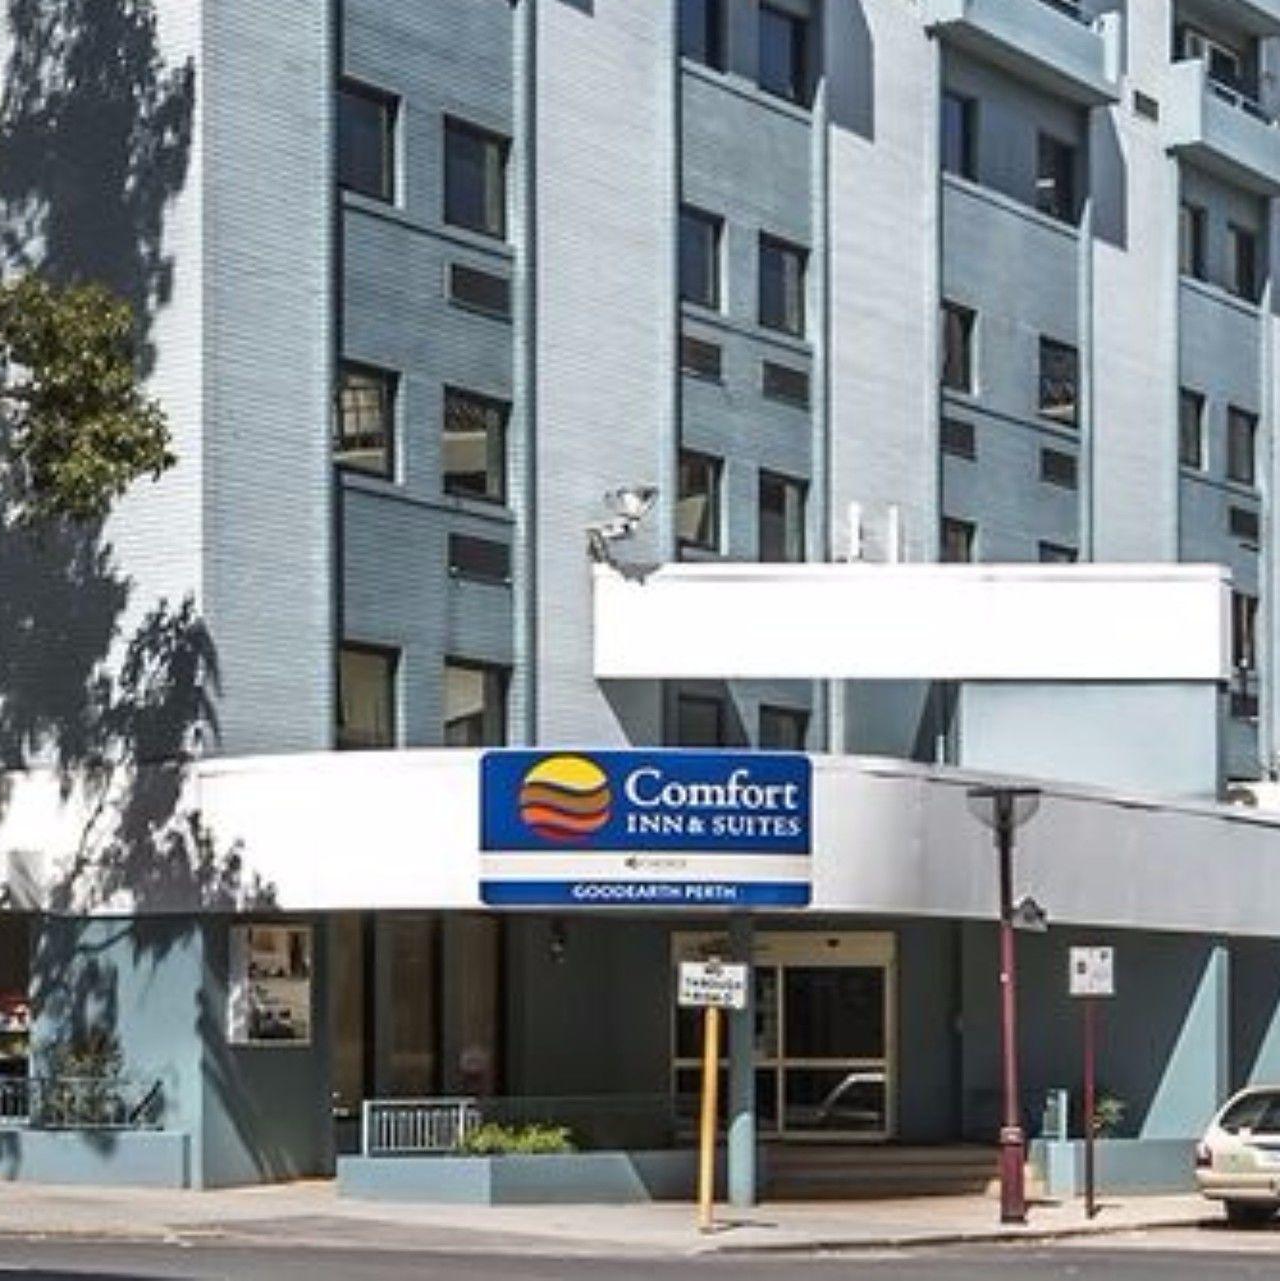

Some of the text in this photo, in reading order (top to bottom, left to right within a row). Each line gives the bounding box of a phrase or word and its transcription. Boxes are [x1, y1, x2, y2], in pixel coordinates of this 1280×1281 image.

[624, 768, 800, 811] Comfort
[625, 814, 802, 838] INN & SUITES
[572, 883, 738, 900] GOODEARTH PERTH
